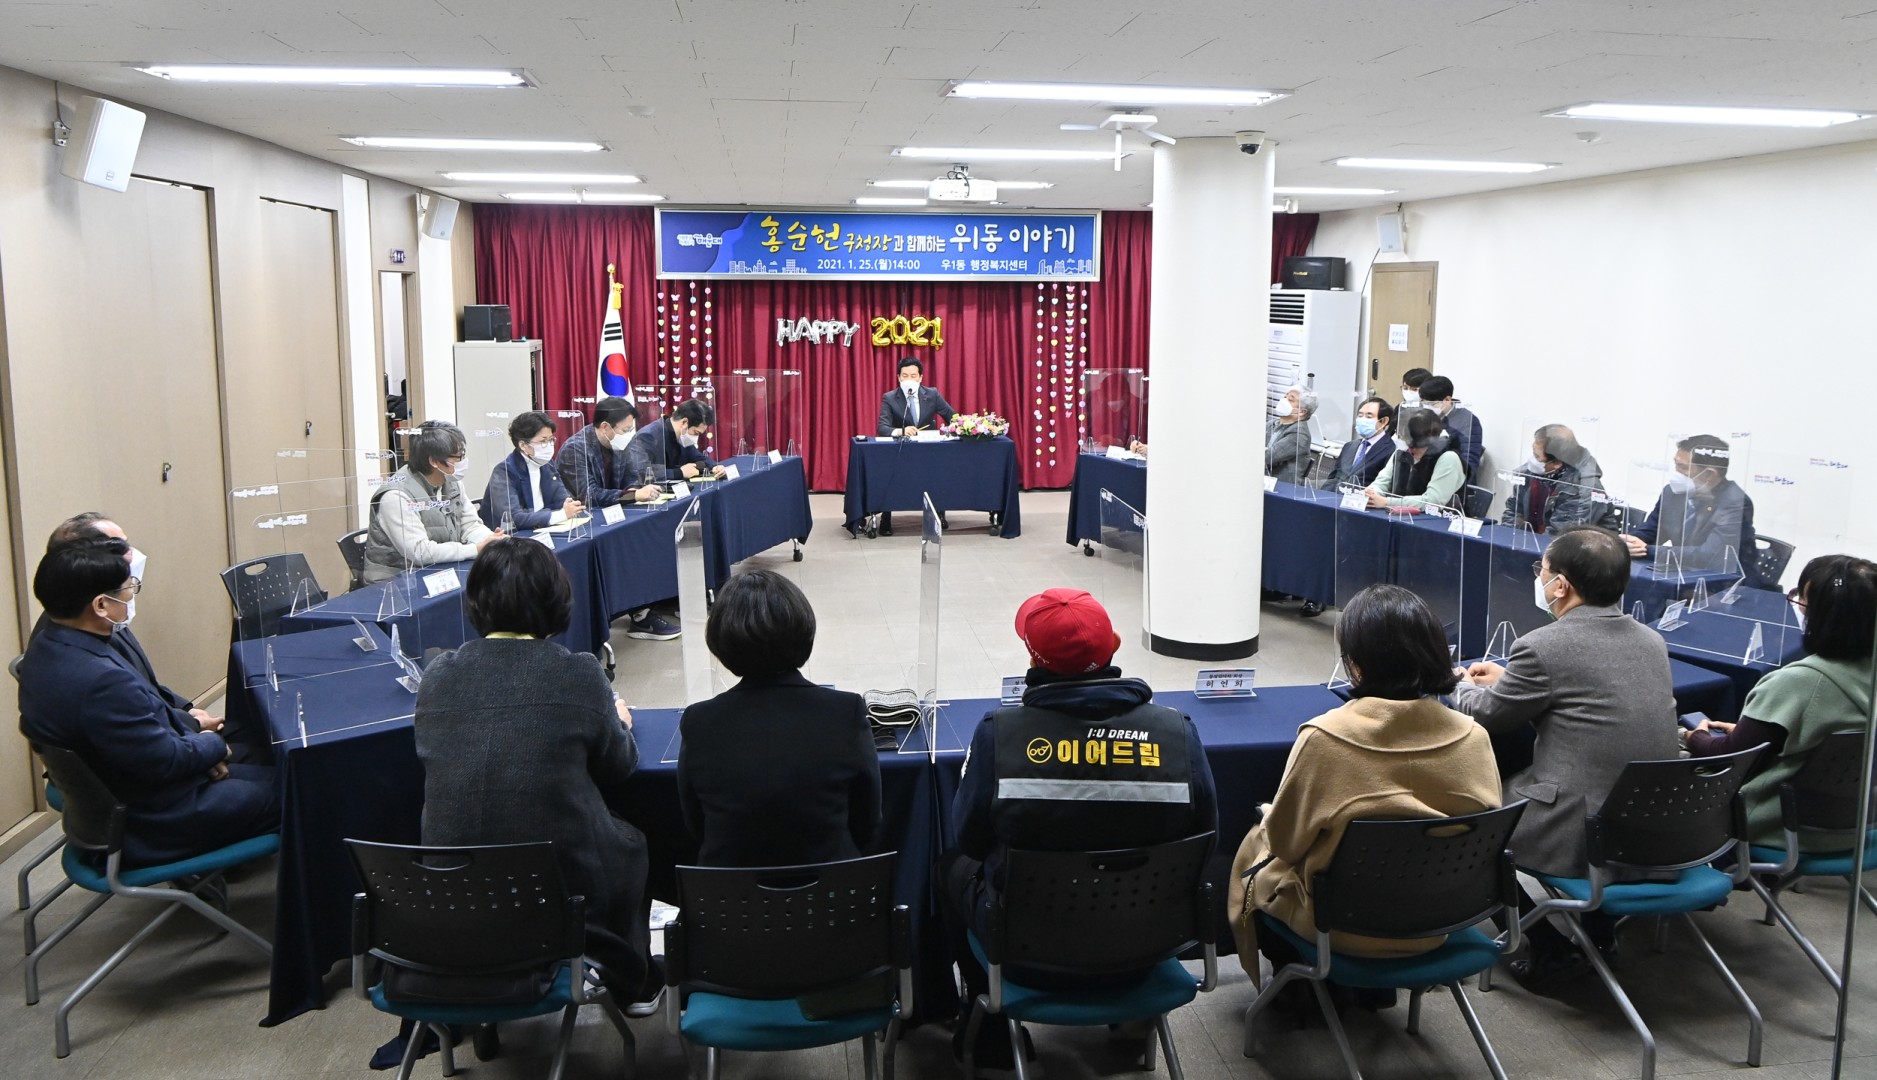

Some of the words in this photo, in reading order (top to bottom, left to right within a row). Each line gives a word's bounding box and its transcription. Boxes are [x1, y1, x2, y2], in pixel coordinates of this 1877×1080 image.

[760, 215, 841, 253] 홍순헌
[907, 234, 947, 252] 함께하는
[1008, 224, 1075, 253] 이야기
[941, 259, 966, 271] 우1동
[970, 259, 1028, 271] 행정복지센터
[776, 316, 860, 347] HAPPY
[871, 314, 944, 350] 2021
[1108, 729, 1149, 741] DREAM
[1057, 740, 1160, 767] 이어드림
